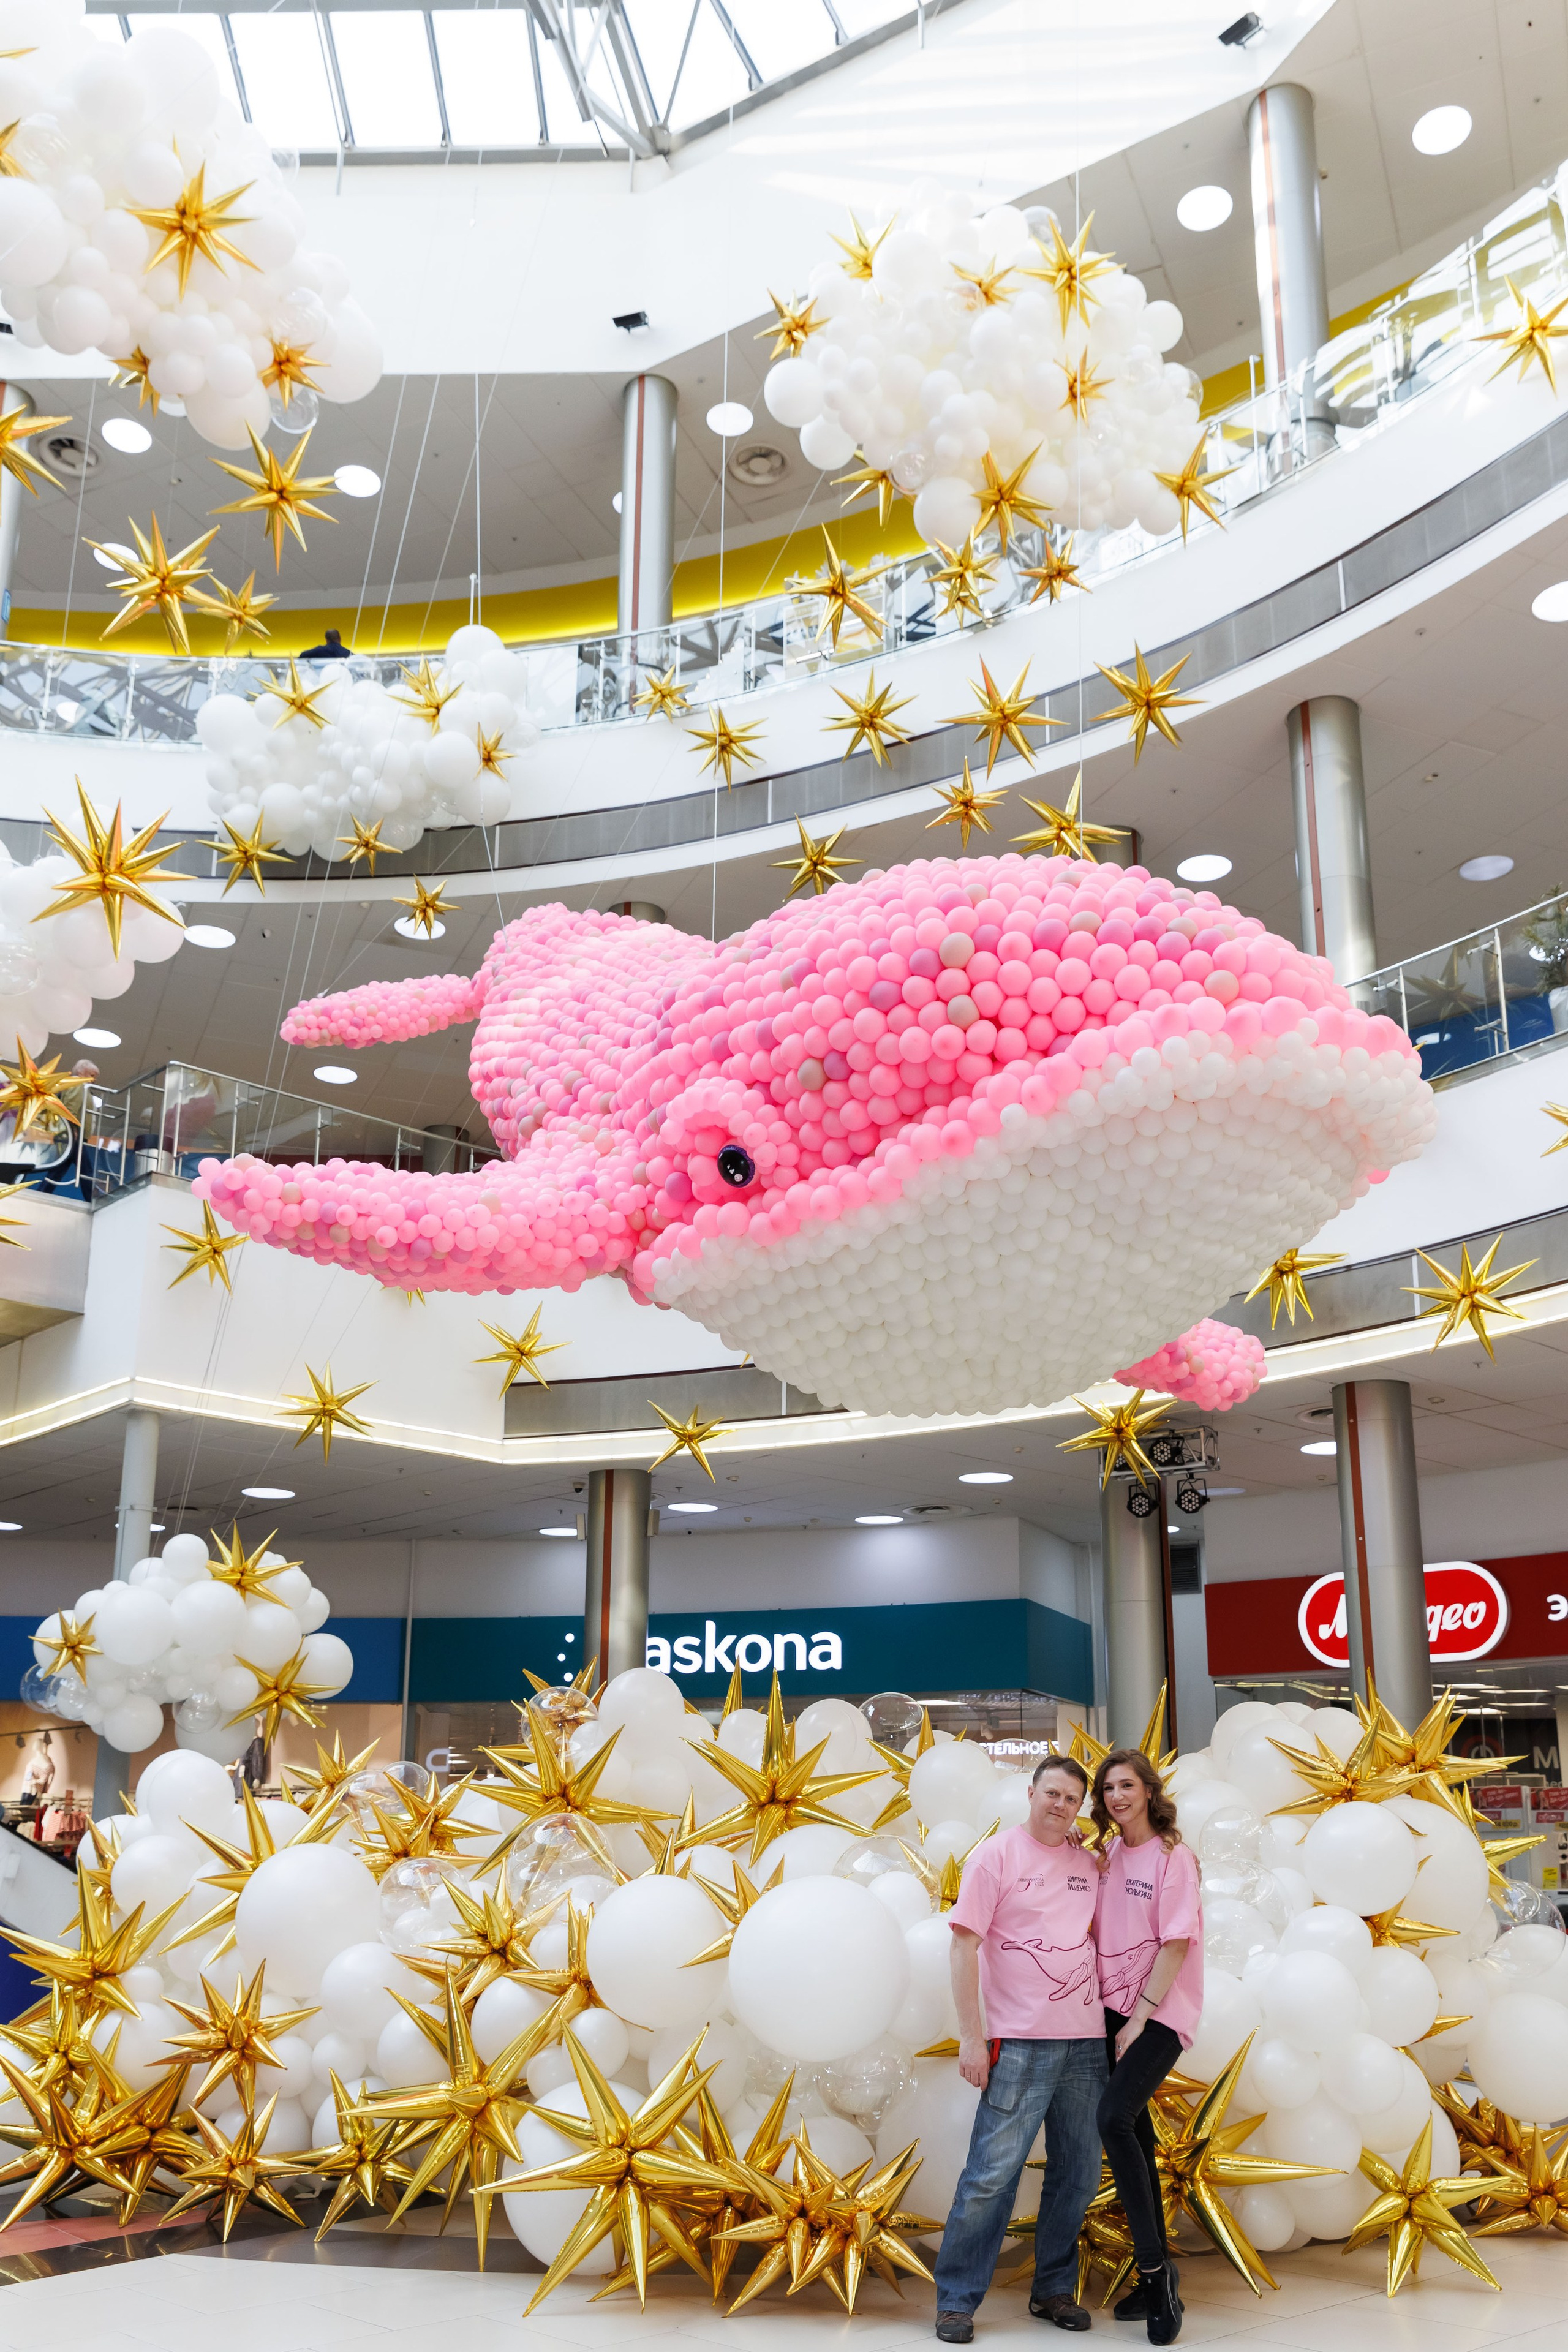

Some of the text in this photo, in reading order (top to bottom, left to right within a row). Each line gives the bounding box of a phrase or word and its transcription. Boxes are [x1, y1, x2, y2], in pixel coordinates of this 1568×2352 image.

[646, 1619, 842, 1675] askona
[1066, 1875, 1088, 1884] ДМИТРИЙ
[1126, 1878, 1153, 1891] ЕКАТЕРИНА
